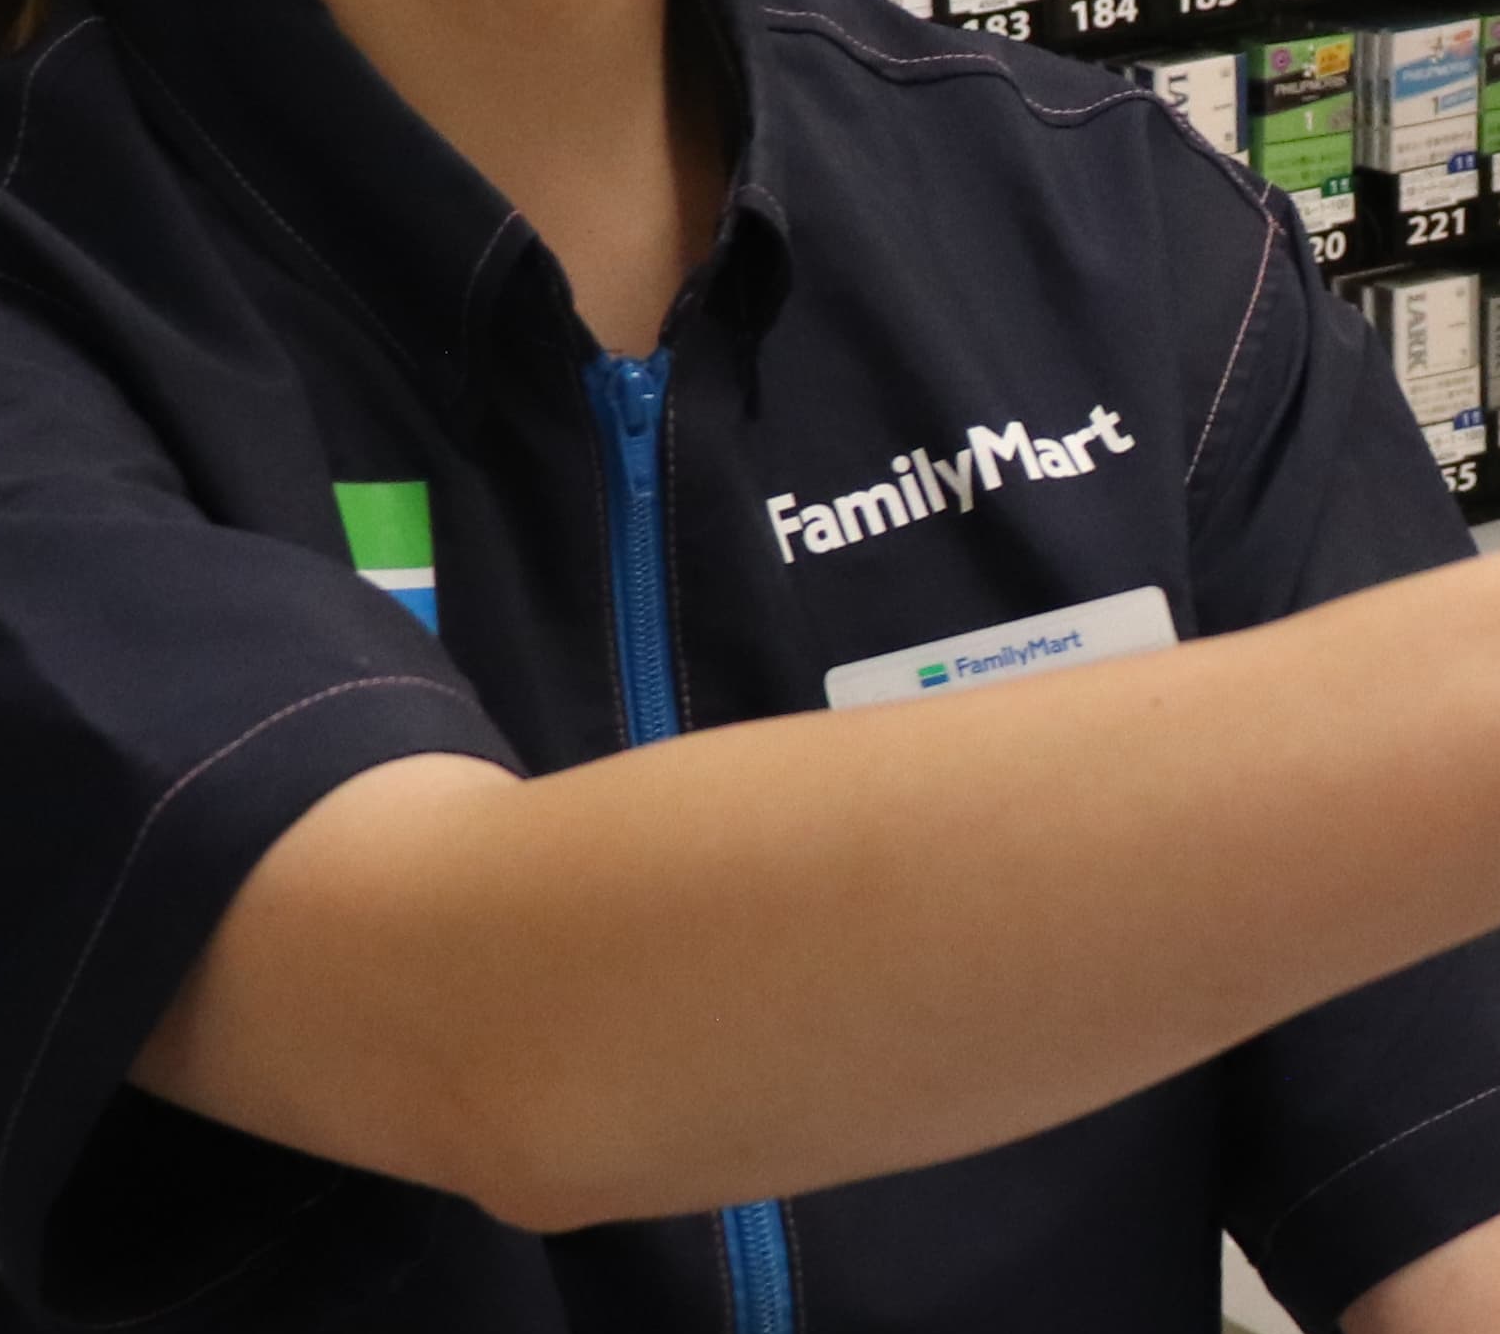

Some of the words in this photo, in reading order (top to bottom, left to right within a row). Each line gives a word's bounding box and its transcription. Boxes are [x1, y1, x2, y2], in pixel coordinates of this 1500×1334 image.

[1407, 208, 1464, 245] 221
[766, 404, 1136, 564] FamilyMart
[953, 628, 1084, 680] FamilyMart
